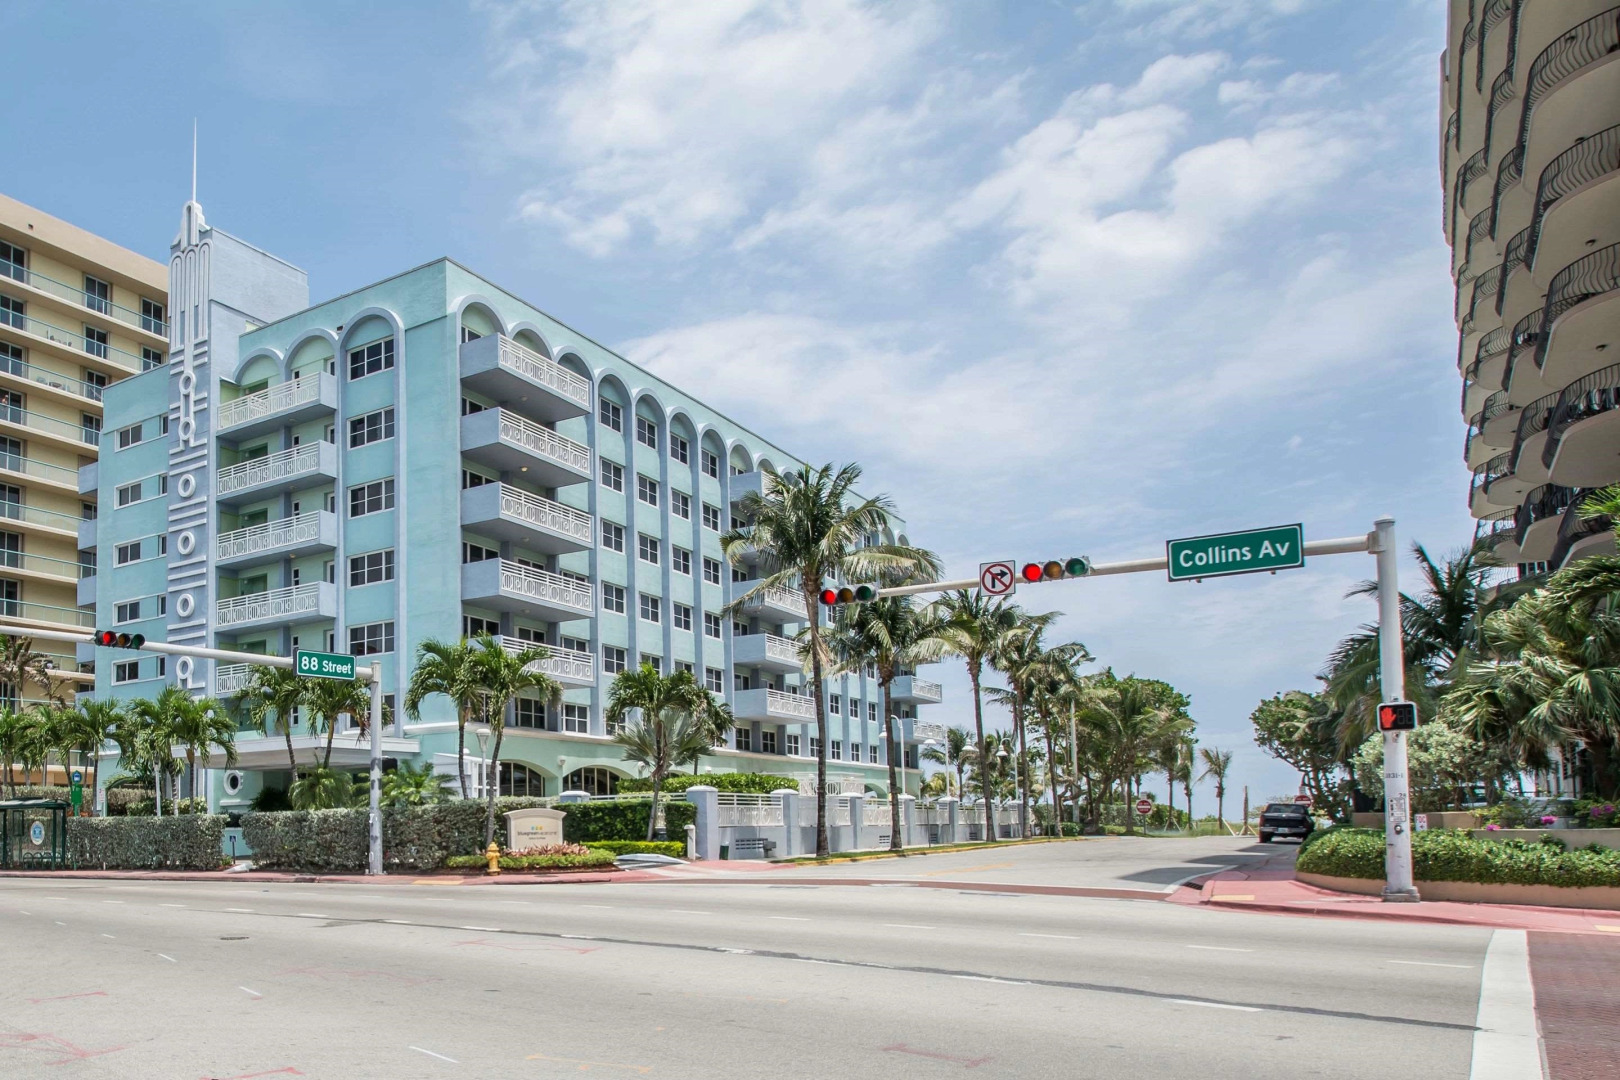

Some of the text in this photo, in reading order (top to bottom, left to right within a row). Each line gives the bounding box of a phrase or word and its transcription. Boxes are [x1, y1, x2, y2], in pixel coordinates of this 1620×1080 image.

[1180, 540, 1290, 567] Collins Av
[301, 656, 352, 675] 88 Street
